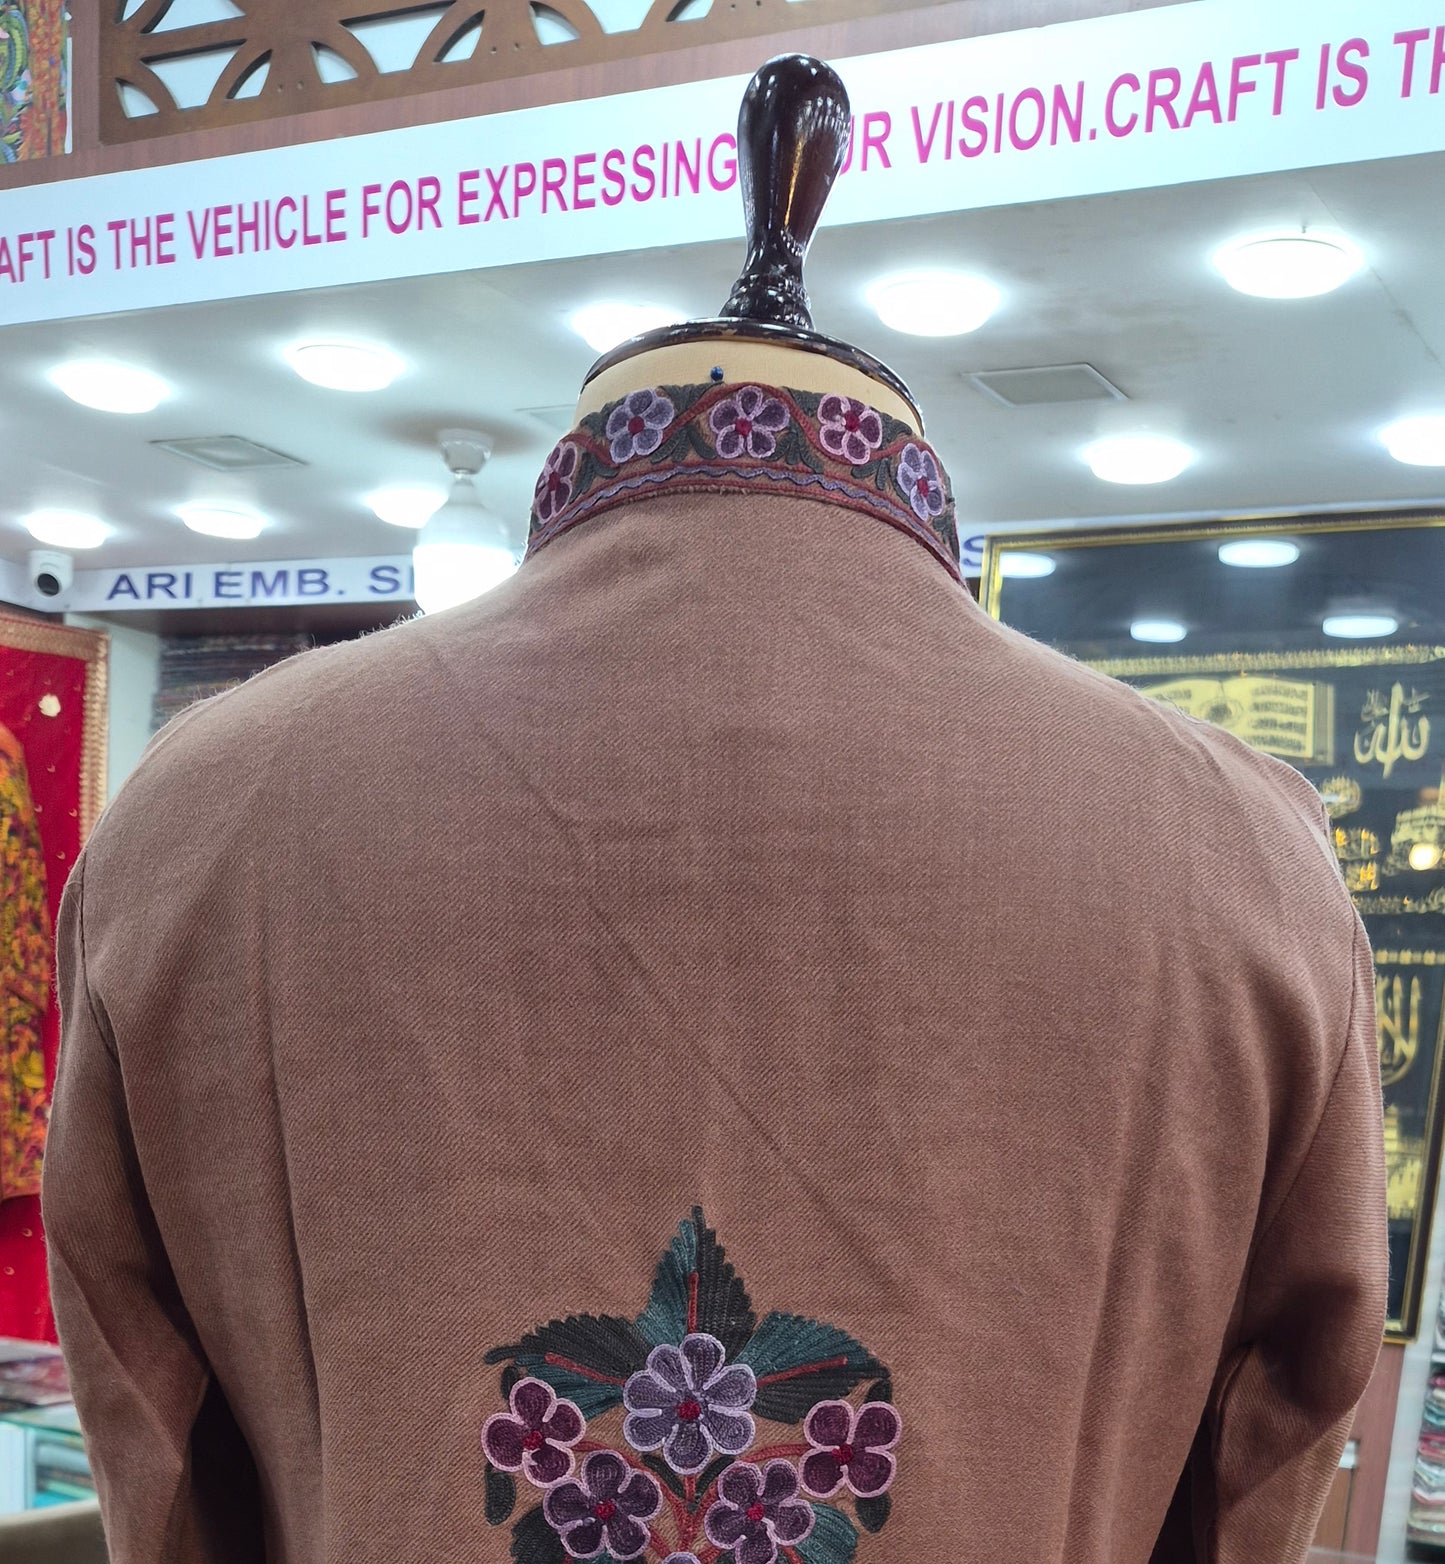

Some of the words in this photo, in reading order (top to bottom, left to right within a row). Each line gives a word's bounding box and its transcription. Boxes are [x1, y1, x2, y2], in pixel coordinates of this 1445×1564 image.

[66, 224, 97, 276] IS
[107, 213, 177, 271] THE
[188, 189, 347, 260] VEHICLE
[362, 177, 443, 237] FOR
[457, 132, 738, 227] EXPRESSING
[1315, 37, 1370, 110] IS
[107, 572, 192, 600] ARI
[214, 568, 345, 598] EMB.
[368, 565, 414, 595] S
